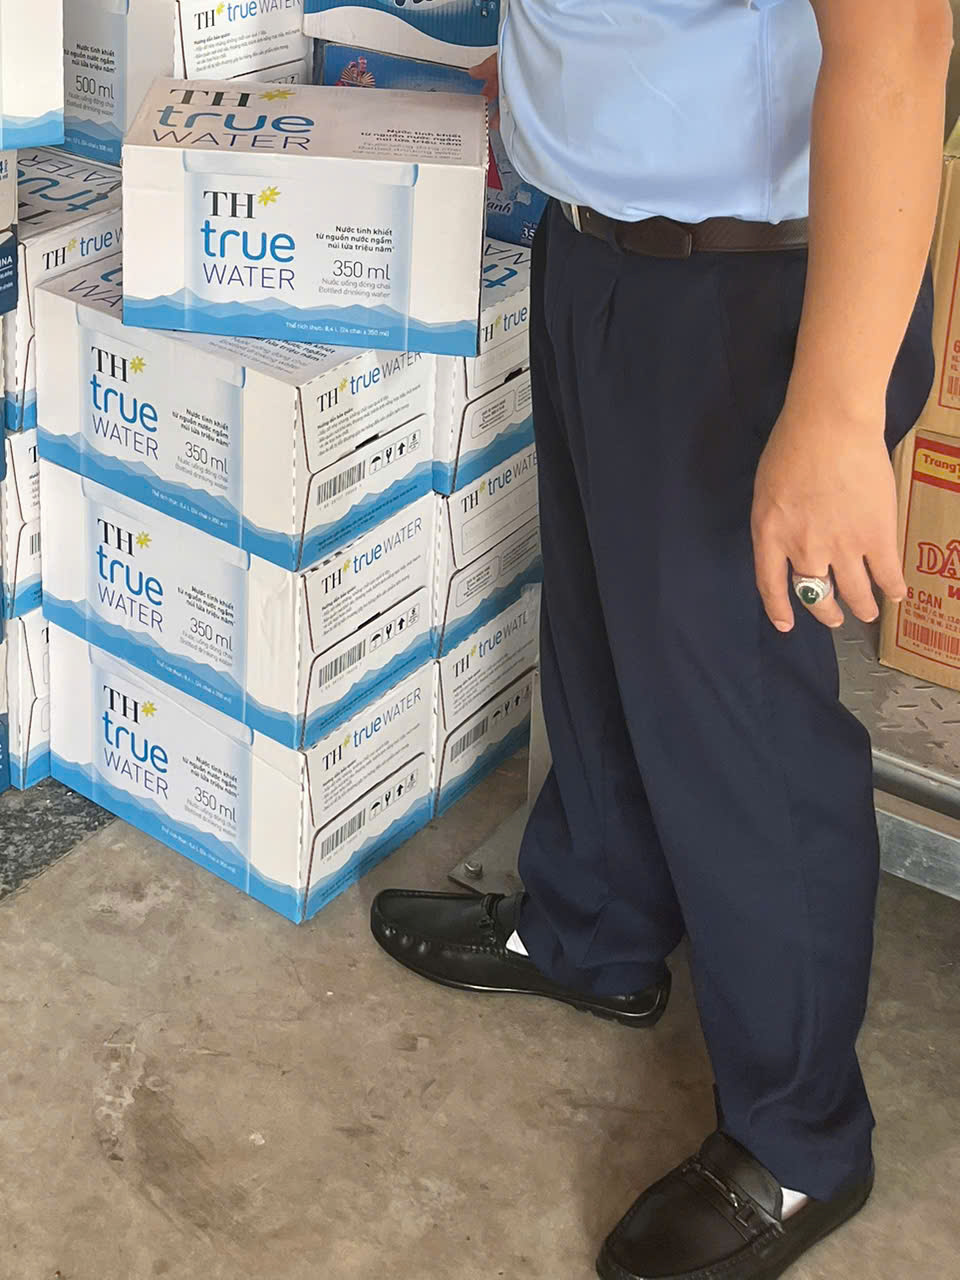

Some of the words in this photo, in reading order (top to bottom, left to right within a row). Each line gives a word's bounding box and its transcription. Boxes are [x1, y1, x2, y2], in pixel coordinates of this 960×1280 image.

[194, 10, 216, 30] TH
[227, 1, 257, 22] true
[75, 74, 96, 95] 500
[98, 83, 115, 100] ml
[169, 89, 262, 108] TH
[157, 105, 316, 132] true
[152, 129, 311, 151] WATER
[203, 190, 256, 218] TH
[42, 246, 67, 270] TH
[79, 230, 113, 257] true
[200, 220, 296, 262] true
[202, 262, 295, 290] WATER
[333, 259, 363, 278] 350
[367, 263, 391, 281] ml
[91, 346, 130, 383] TH
[90, 373, 158, 433] true
[317, 388, 338, 412] TH
[350, 366, 381, 395] true
[92, 413, 159, 461] WATER
[185, 441, 208, 465] 350
[210, 456, 229, 474] ml
[97, 518, 135, 557] TH
[321, 571, 342, 594] TH
[353, 543, 383, 574] true
[383, 516, 422, 552] WATER
[96, 545, 164, 606] true
[97, 583, 164, 633] WATER
[907, 586, 914, 600] 6
[918, 590, 942, 610] CAN
[190, 617, 213, 641] 350
[215, 633, 233, 651] ml
[103, 685, 140, 725] TH
[102, 711, 168, 773] true
[323, 745, 343, 770] TH
[352, 717, 381, 748] true
[381, 687, 422, 725] WATER
[103, 747, 169, 800] WATER
[194, 786, 217, 811] 350
[219, 803, 237, 823] ml
